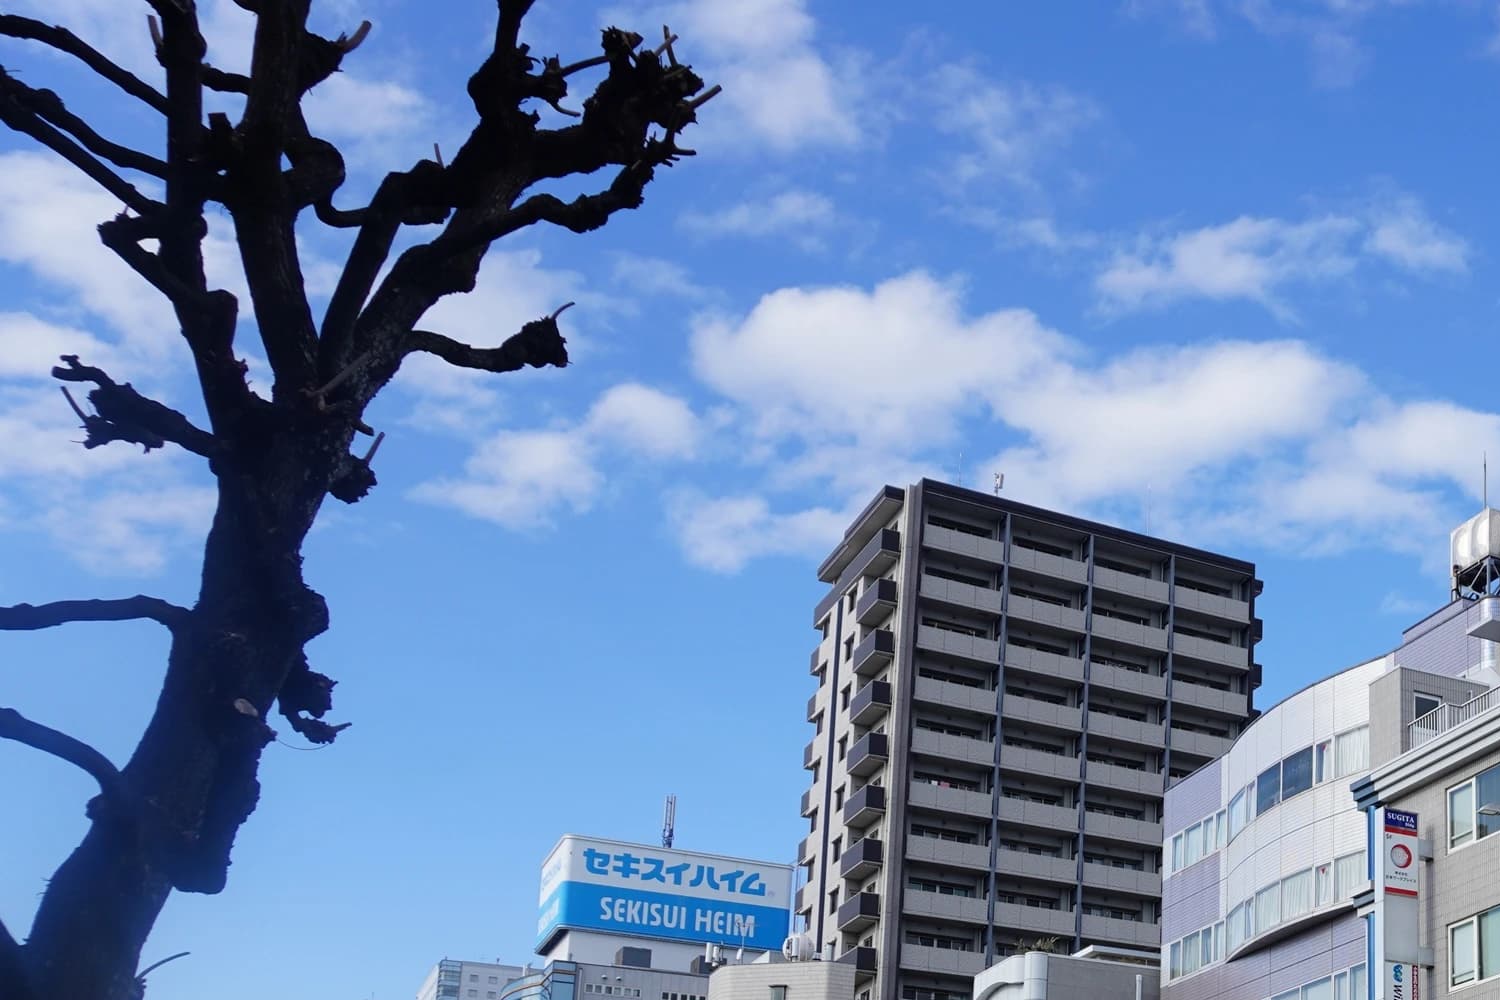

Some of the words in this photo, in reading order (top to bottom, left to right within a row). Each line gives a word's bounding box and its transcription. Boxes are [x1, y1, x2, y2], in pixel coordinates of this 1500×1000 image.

[1386, 812, 1415, 823] SUGITA
[583, 848, 766, 897] セキスイハイム
[600, 896, 687, 931] SEKISUI
[695, 907, 756, 939] HEIM
